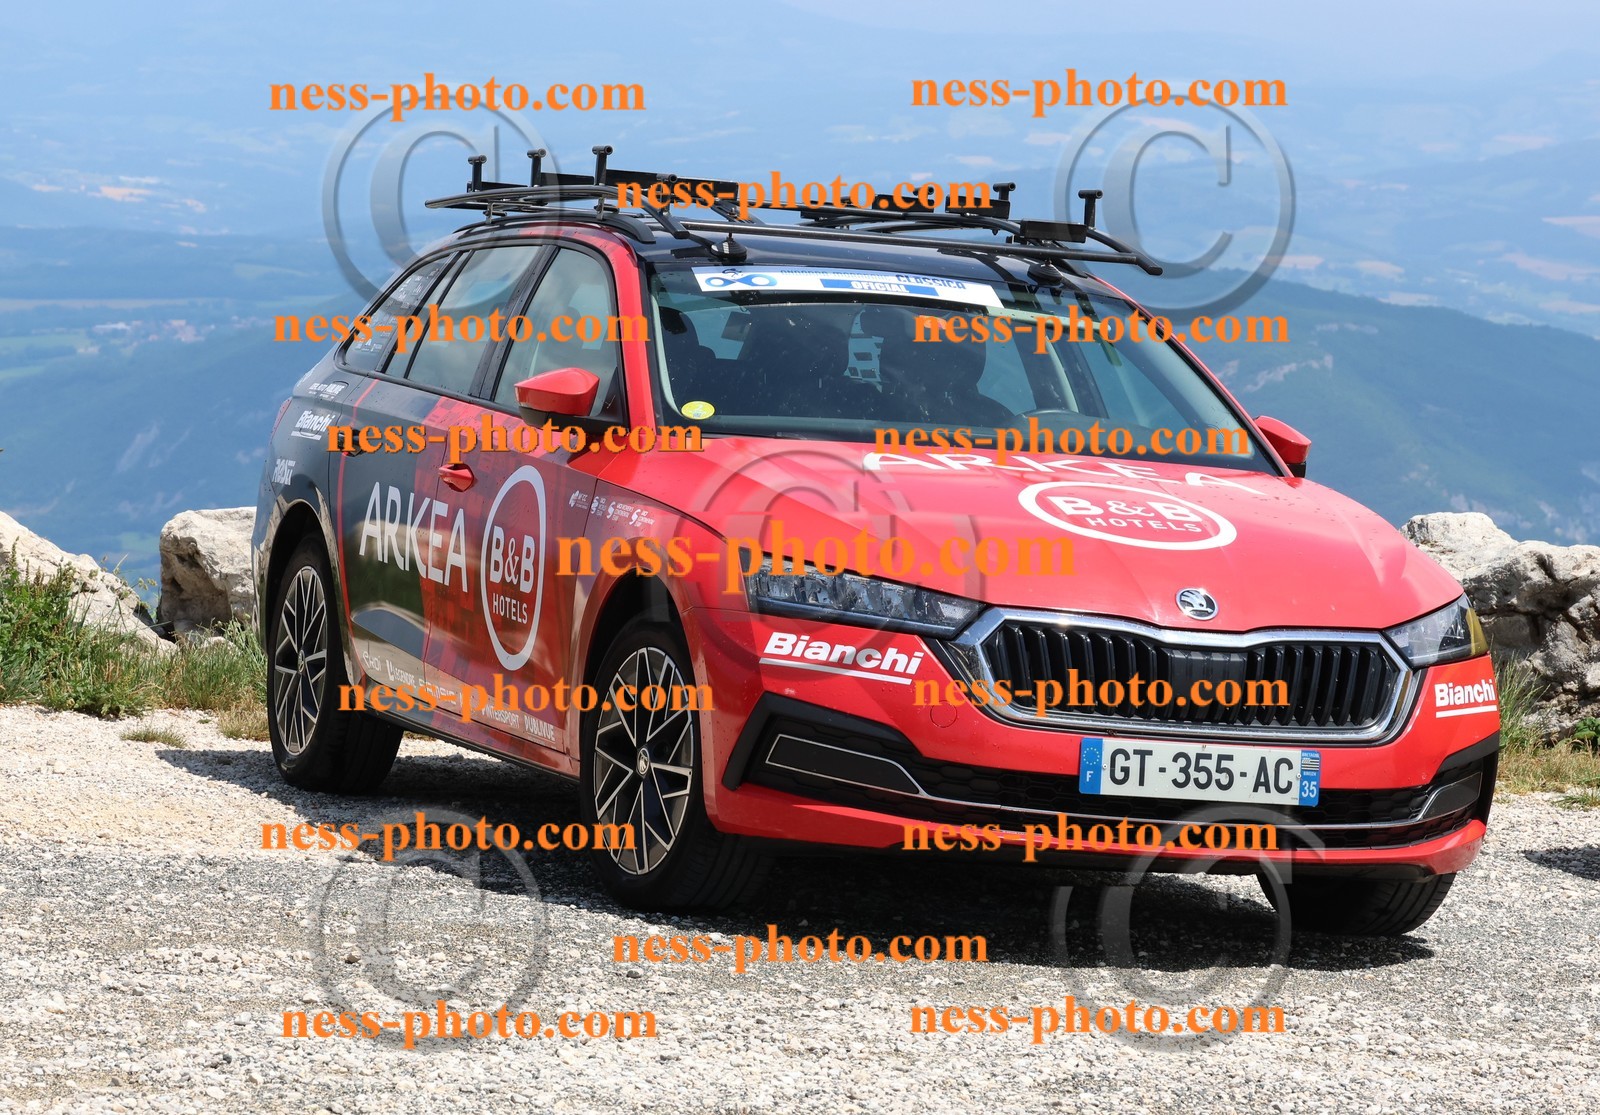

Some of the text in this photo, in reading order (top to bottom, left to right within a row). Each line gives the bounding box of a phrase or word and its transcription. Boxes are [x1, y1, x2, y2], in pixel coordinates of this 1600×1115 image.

[850, 280, 910, 293] OFICIAL
[294, 410, 336, 433] Bianchi
[863, 451, 1265, 496] ARKEA
[1046, 495, 1203, 522] B&B
[359, 481, 468, 594] ARKEA
[1084, 517, 1203, 533] HOTELS
[489, 525, 536, 594] B&B
[492, 592, 529, 625] HOTELS
[763, 631, 925, 675] Bianchi
[1434, 679, 1497, 707] Bianchi
[1086, 771, 1094, 782] F
[1108, 748, 1295, 795] GT-355-AC
[1301, 780, 1317, 798] 35
